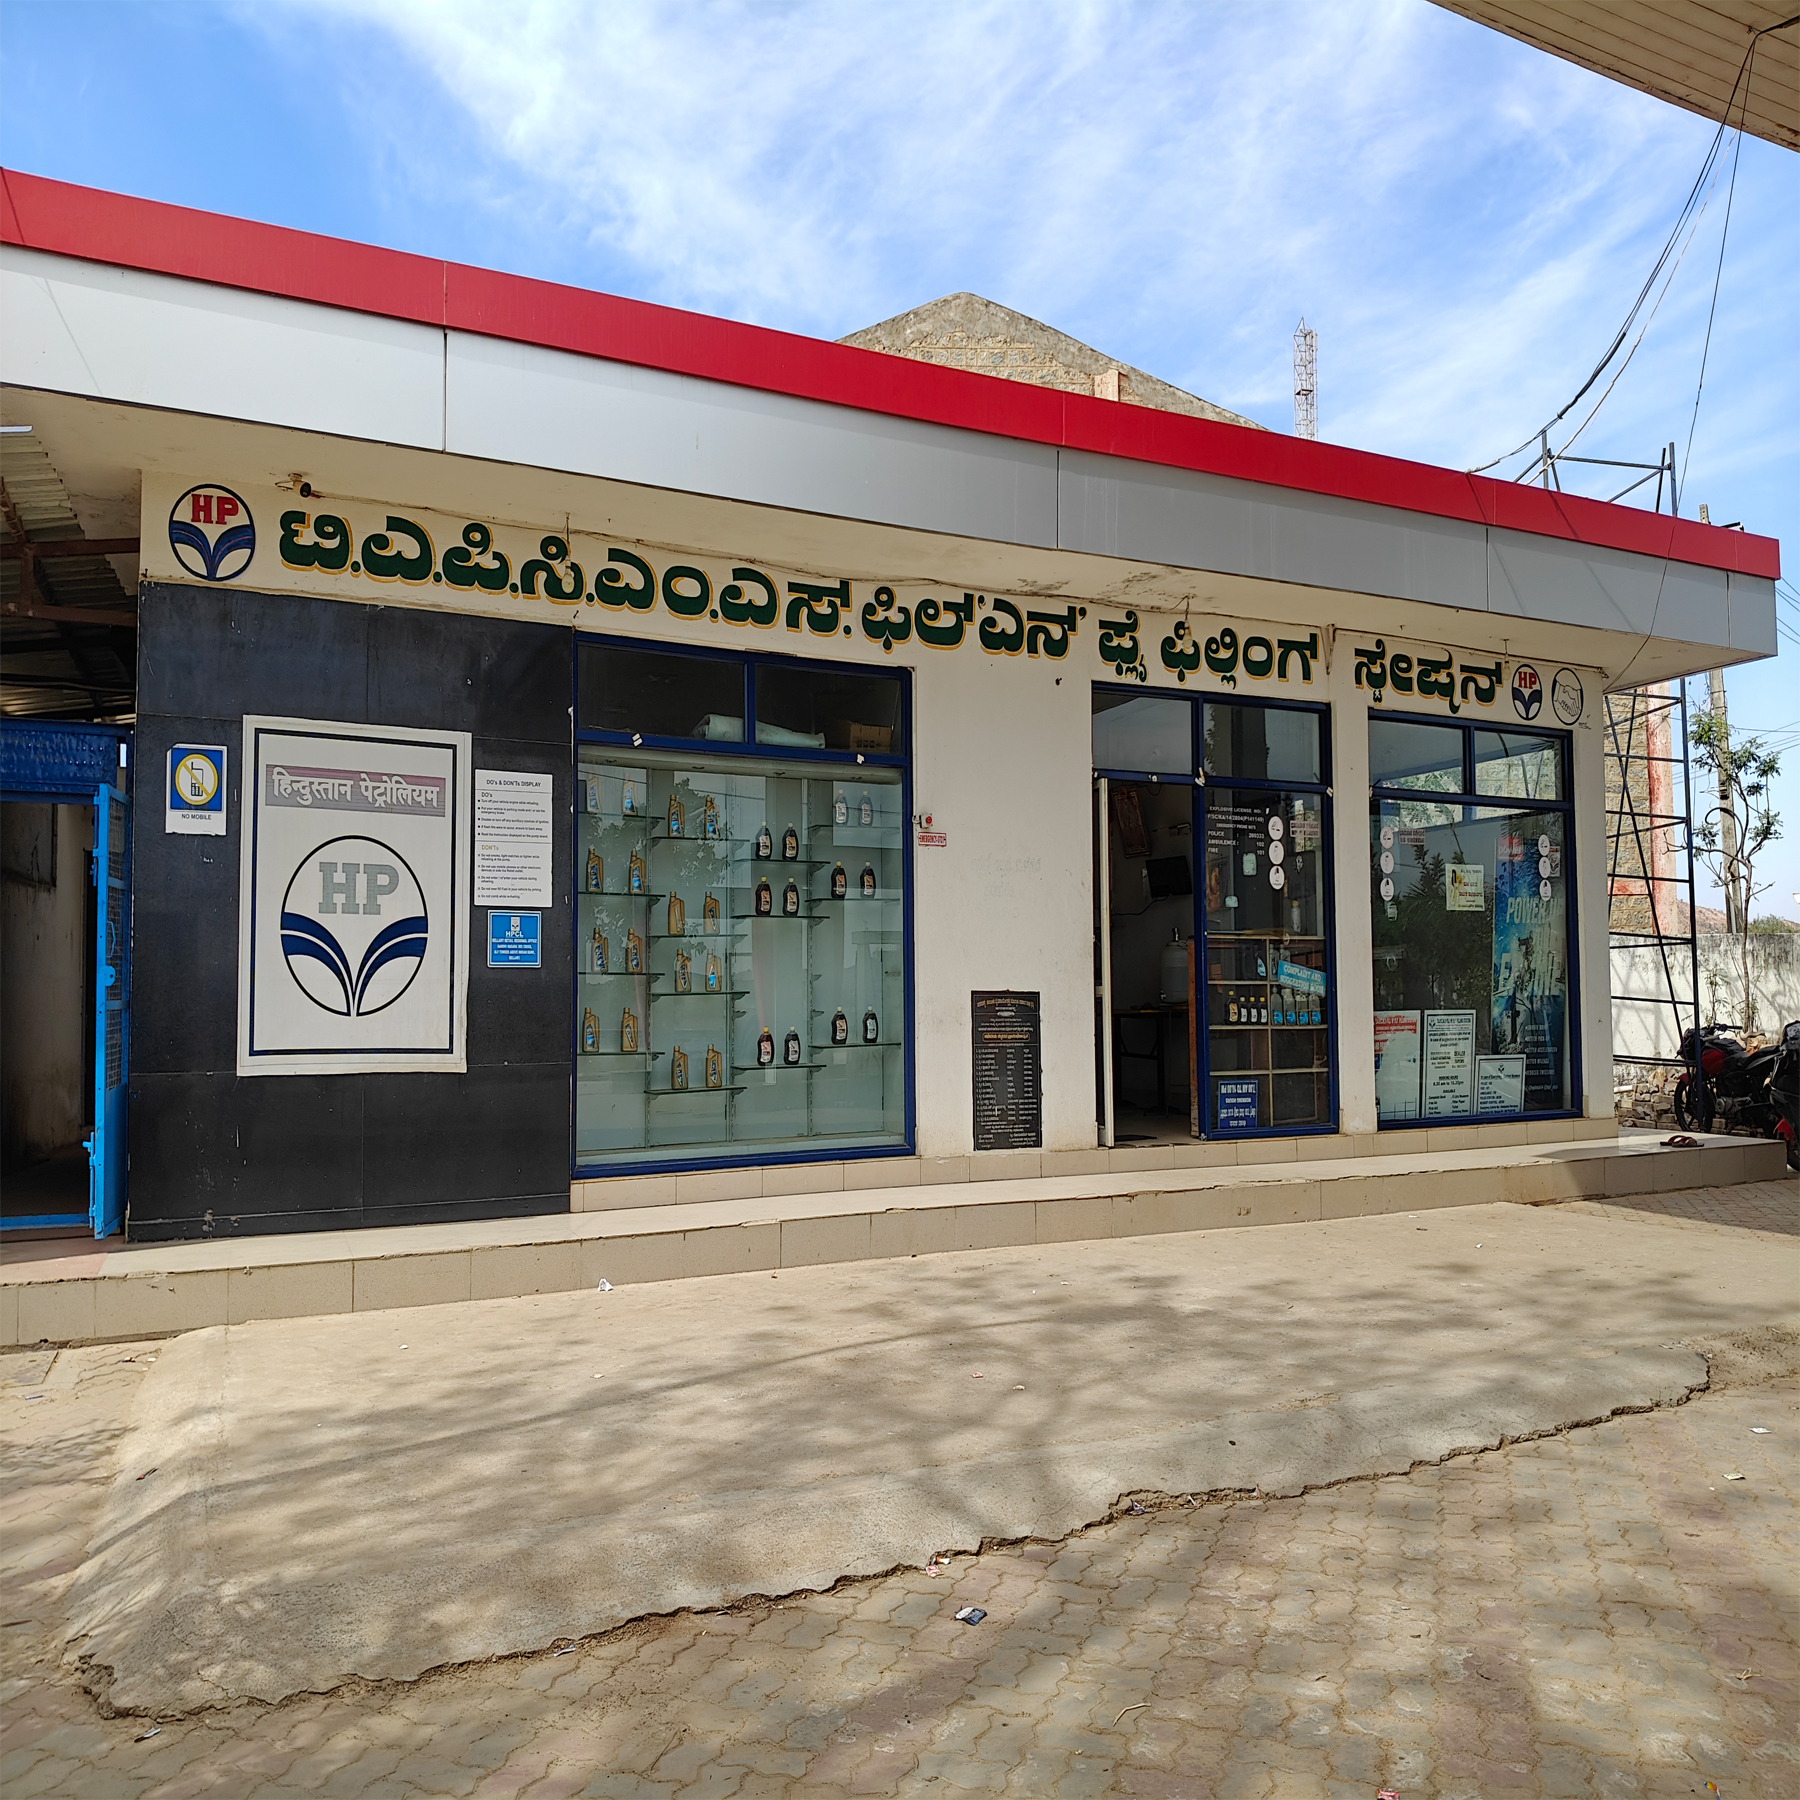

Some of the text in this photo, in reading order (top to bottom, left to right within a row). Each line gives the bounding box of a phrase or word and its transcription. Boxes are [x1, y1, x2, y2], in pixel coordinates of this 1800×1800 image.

[190, 493, 239, 525] HP
[1517, 671, 1537, 689] HP
[272, 766, 440, 808] हिन्दुस्तान पेट्रोलियम
[319, 861, 399, 915] HP
